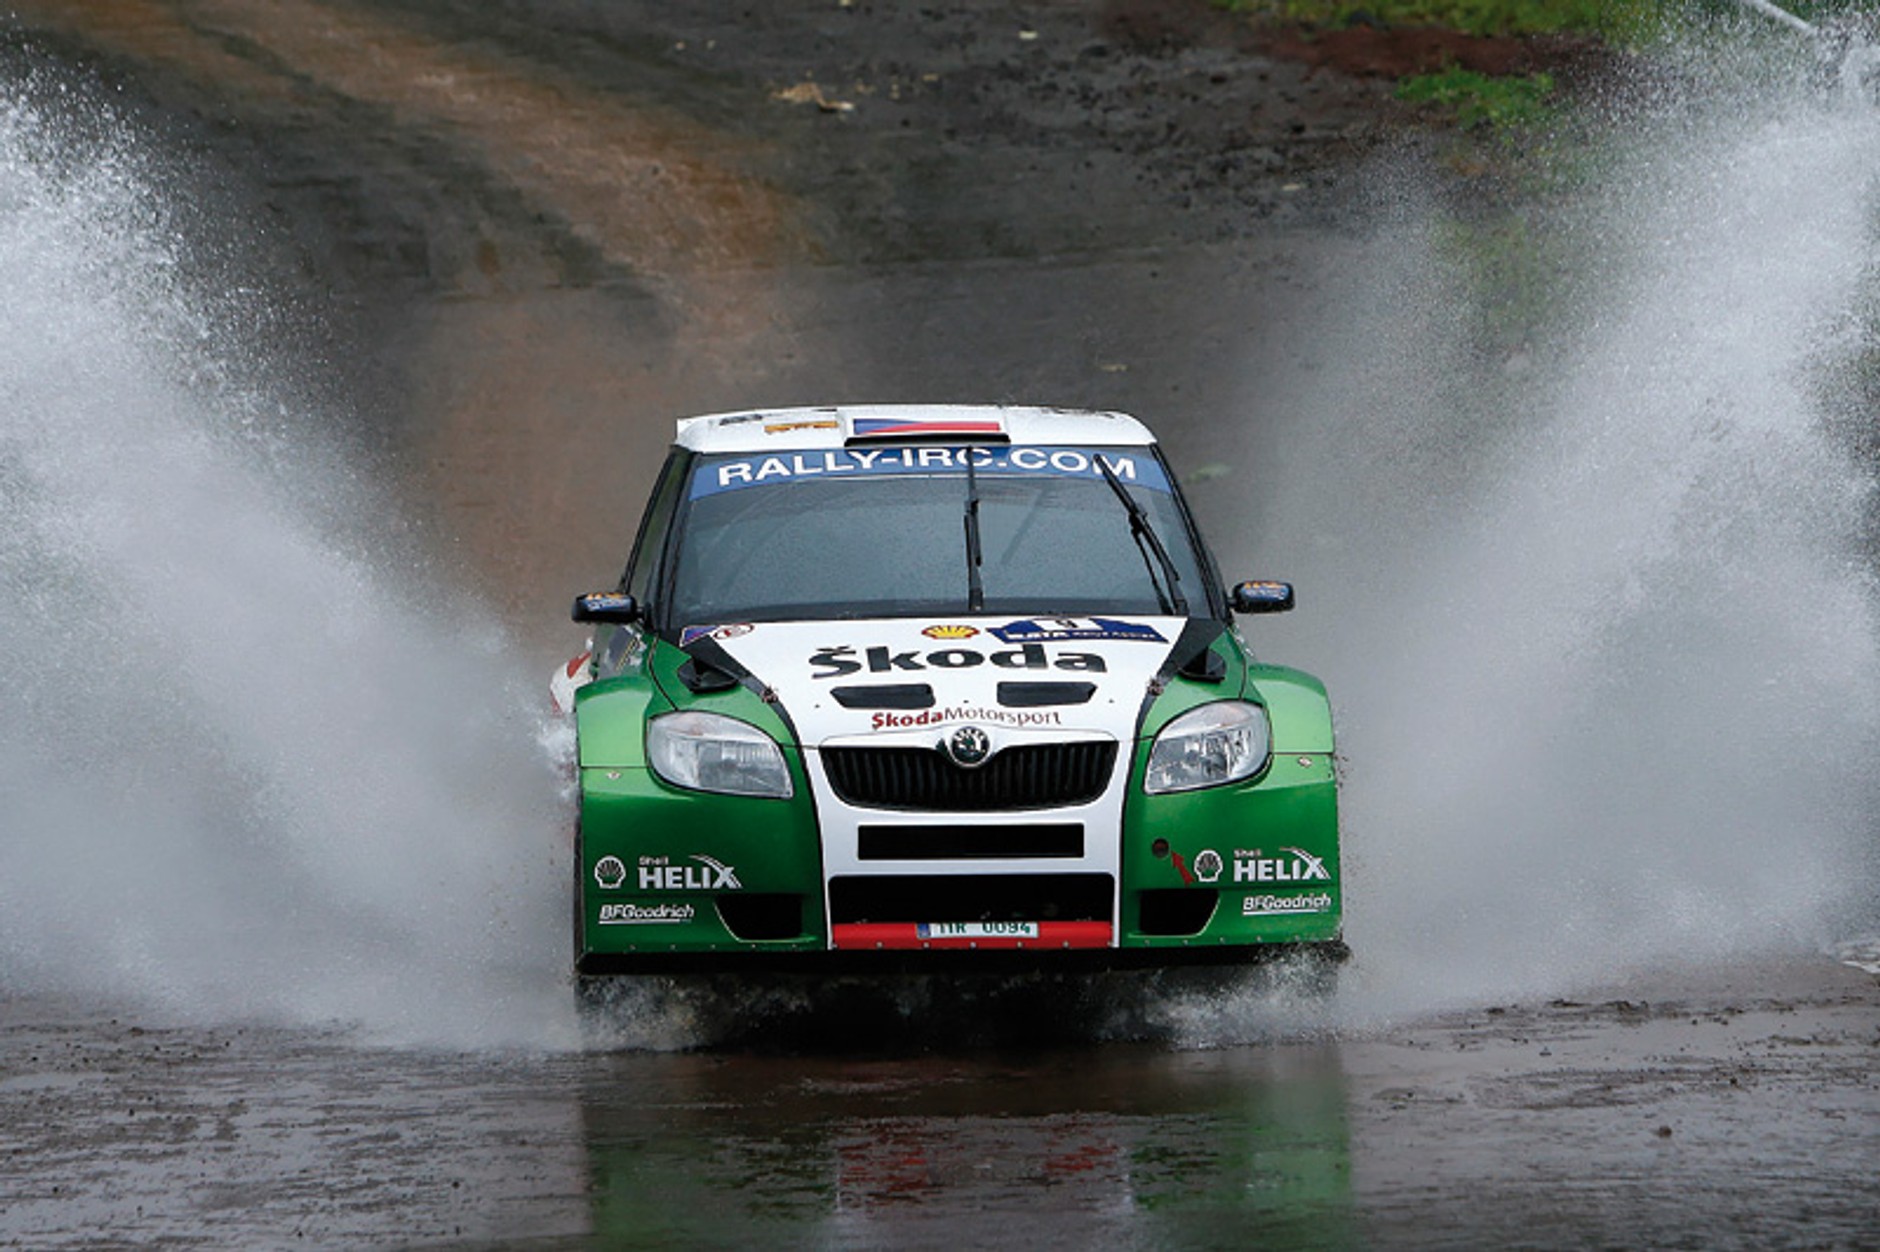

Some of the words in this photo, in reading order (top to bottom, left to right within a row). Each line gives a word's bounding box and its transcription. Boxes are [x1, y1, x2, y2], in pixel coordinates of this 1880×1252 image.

[717, 447, 1137, 487] RALLY-IRC.COM
[638, 860, 743, 889] HELIX
[1233, 853, 1331, 882] HELIX
[599, 903, 695, 920] BFGoodrich
[1242, 893, 1332, 911] BFGoodrich
